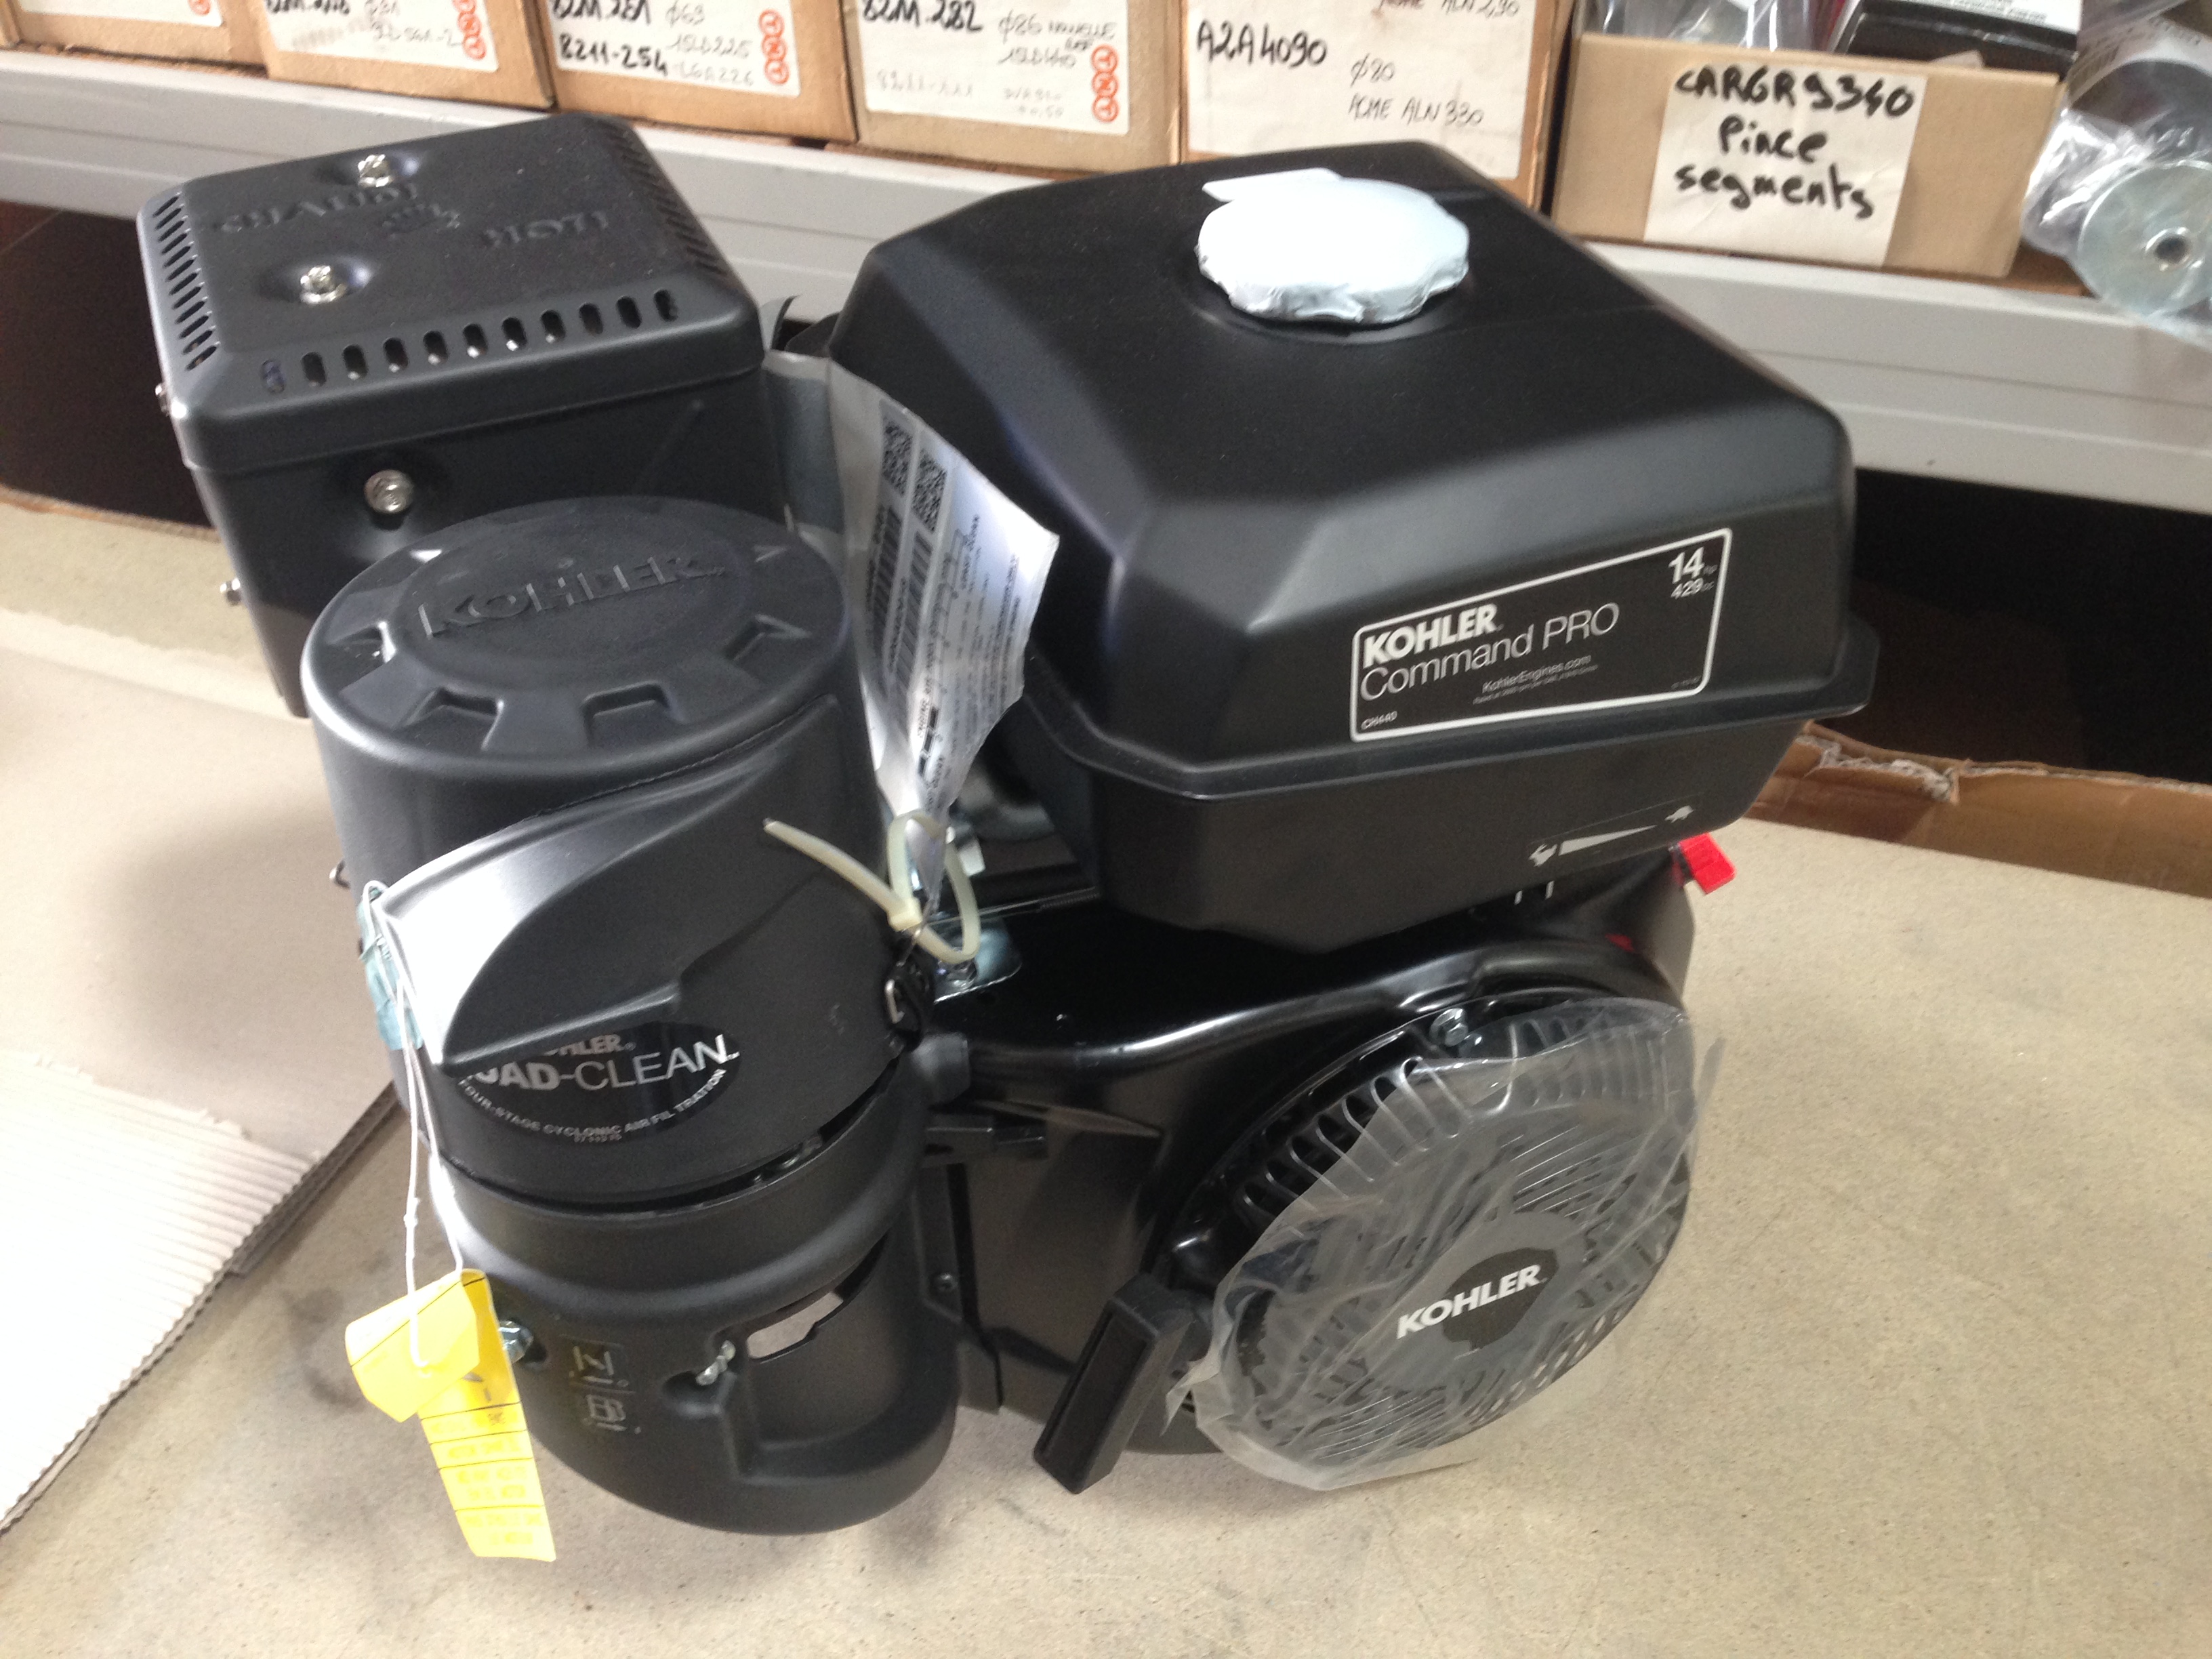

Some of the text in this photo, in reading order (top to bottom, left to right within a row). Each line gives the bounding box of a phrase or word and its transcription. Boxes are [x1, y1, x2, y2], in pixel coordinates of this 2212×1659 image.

[1197, 18, 1328, 70] A2A4090
[1675, 161, 1874, 220] segments
[1668, 546, 1705, 584] 14
[418, 556, 713, 640] KOHLER
[1360, 623, 1535, 701] Command
[1542, 602, 1620, 651] PRO
[1362, 603, 1498, 670] KOHLER
[474, 1033, 726, 1090] UAD-CLEAN
[1396, 1264, 1542, 1340] KOHLER
